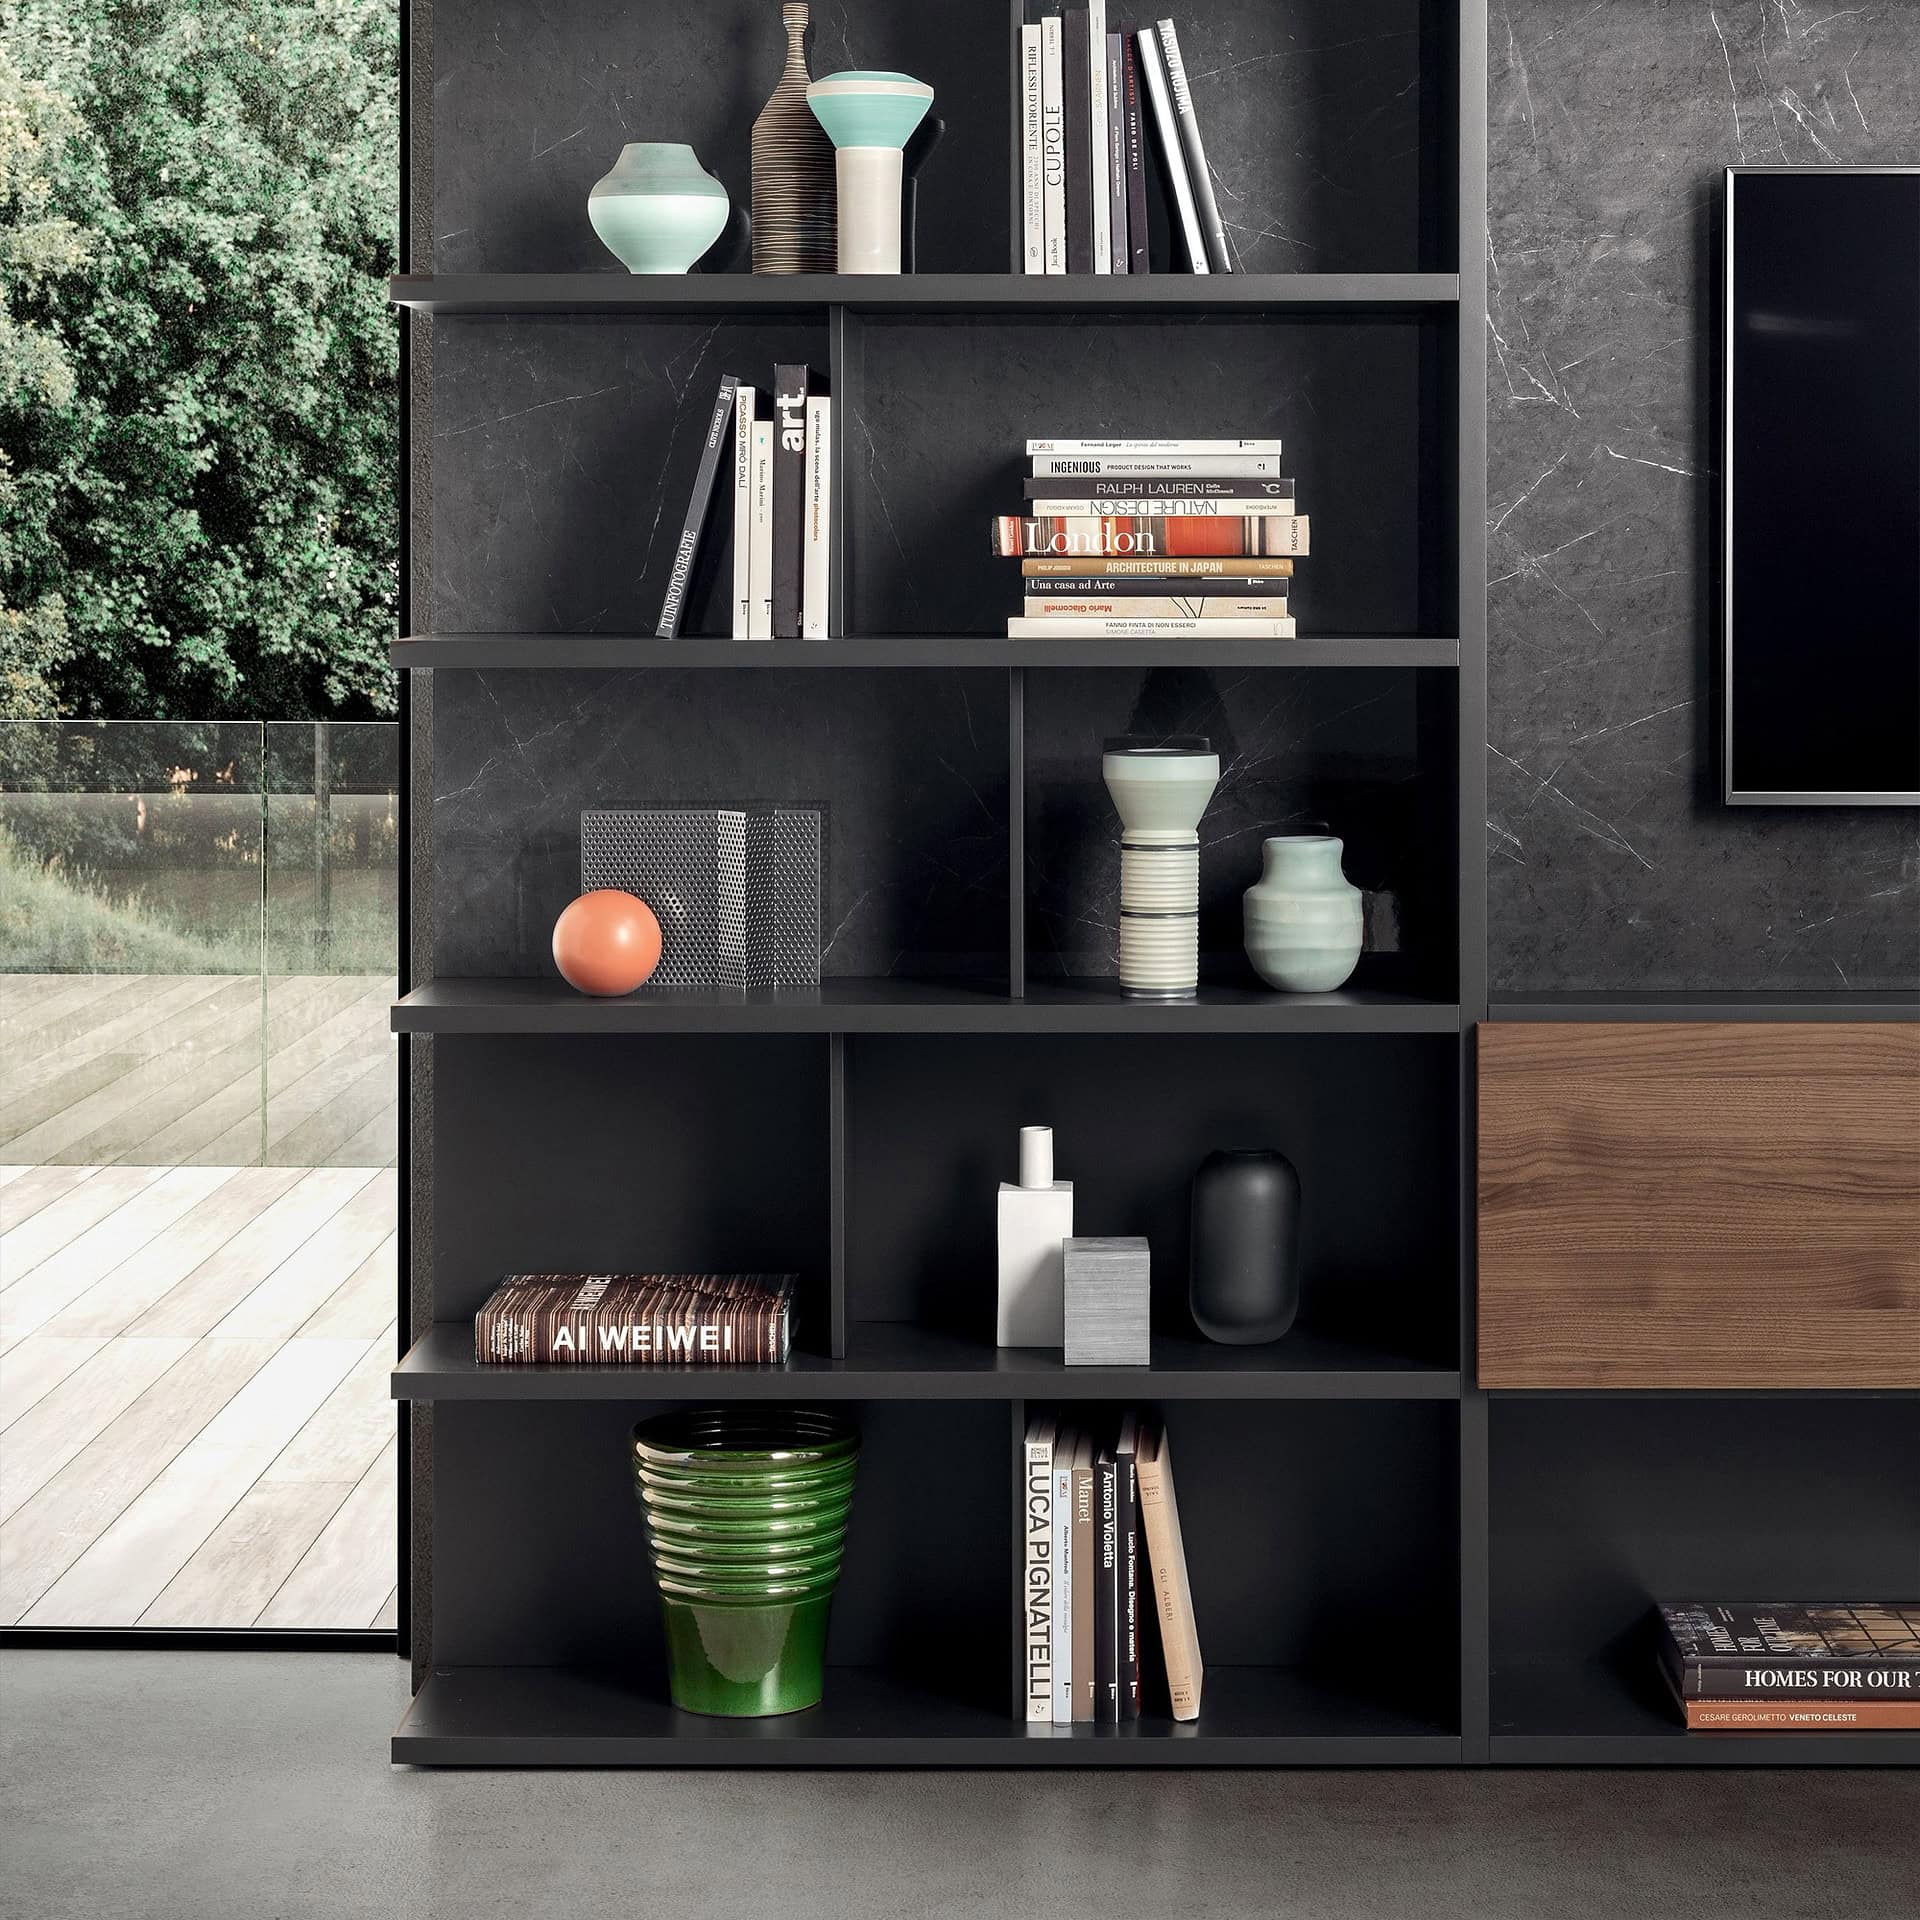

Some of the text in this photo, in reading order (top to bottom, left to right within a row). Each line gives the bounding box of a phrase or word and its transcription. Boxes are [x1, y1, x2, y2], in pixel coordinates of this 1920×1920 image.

[1160, 24, 1192, 115] YASUZO NOJIMA
[1028, 46, 1037, 151] RIFLESSI D'ORIENTE
[1045, 105, 1061, 186] CUPOLE
[739, 395, 747, 438] PICASSO
[1050, 461, 1101, 474] INGENIOUS
[1096, 483, 1205, 495] RALPH LAUREN
[1090, 500, 1150, 515] DESIGN
[1152, 500, 1218, 515] NATURE
[1024, 521, 1156, 554] London
[1106, 561, 1177, 573] ARCHITECTURE
[1179, 562, 1189, 573] IN
[1190, 562, 1223, 573] JAPAN
[660, 529, 697, 631] TUINFOTOGRAFIE
[1031, 579, 1116, 590] Una casa ad Arte
[1044, 604, 1087, 613] Giacomelli
[1089, 604, 1112, 613] Mario
[553, 1326, 586, 1351] AI
[598, 1326, 731, 1351] WEIWEI
[1078, 1476, 1093, 1525] Manet
[1103, 1471, 1114, 1569] Antonio Violetta
[1028, 1461, 1050, 1700] LUCA PIGNATELLI
[1127, 1591, 1135, 1623] Disegno
[1159, 1568, 1173, 1622] GLI ALBERI
[1706, 1626, 1738, 1652] HOMES
[1737, 1636, 1766, 1652] FOR
[1745, 1670, 1818, 1688] HOMES
[1823, 1670, 1863, 1688] FOR
[1867, 1670, 1911, 1688] OUR
[1699, 1713, 1857, 1722] CESARE GEROLIMETTO VENETO CELESTE
